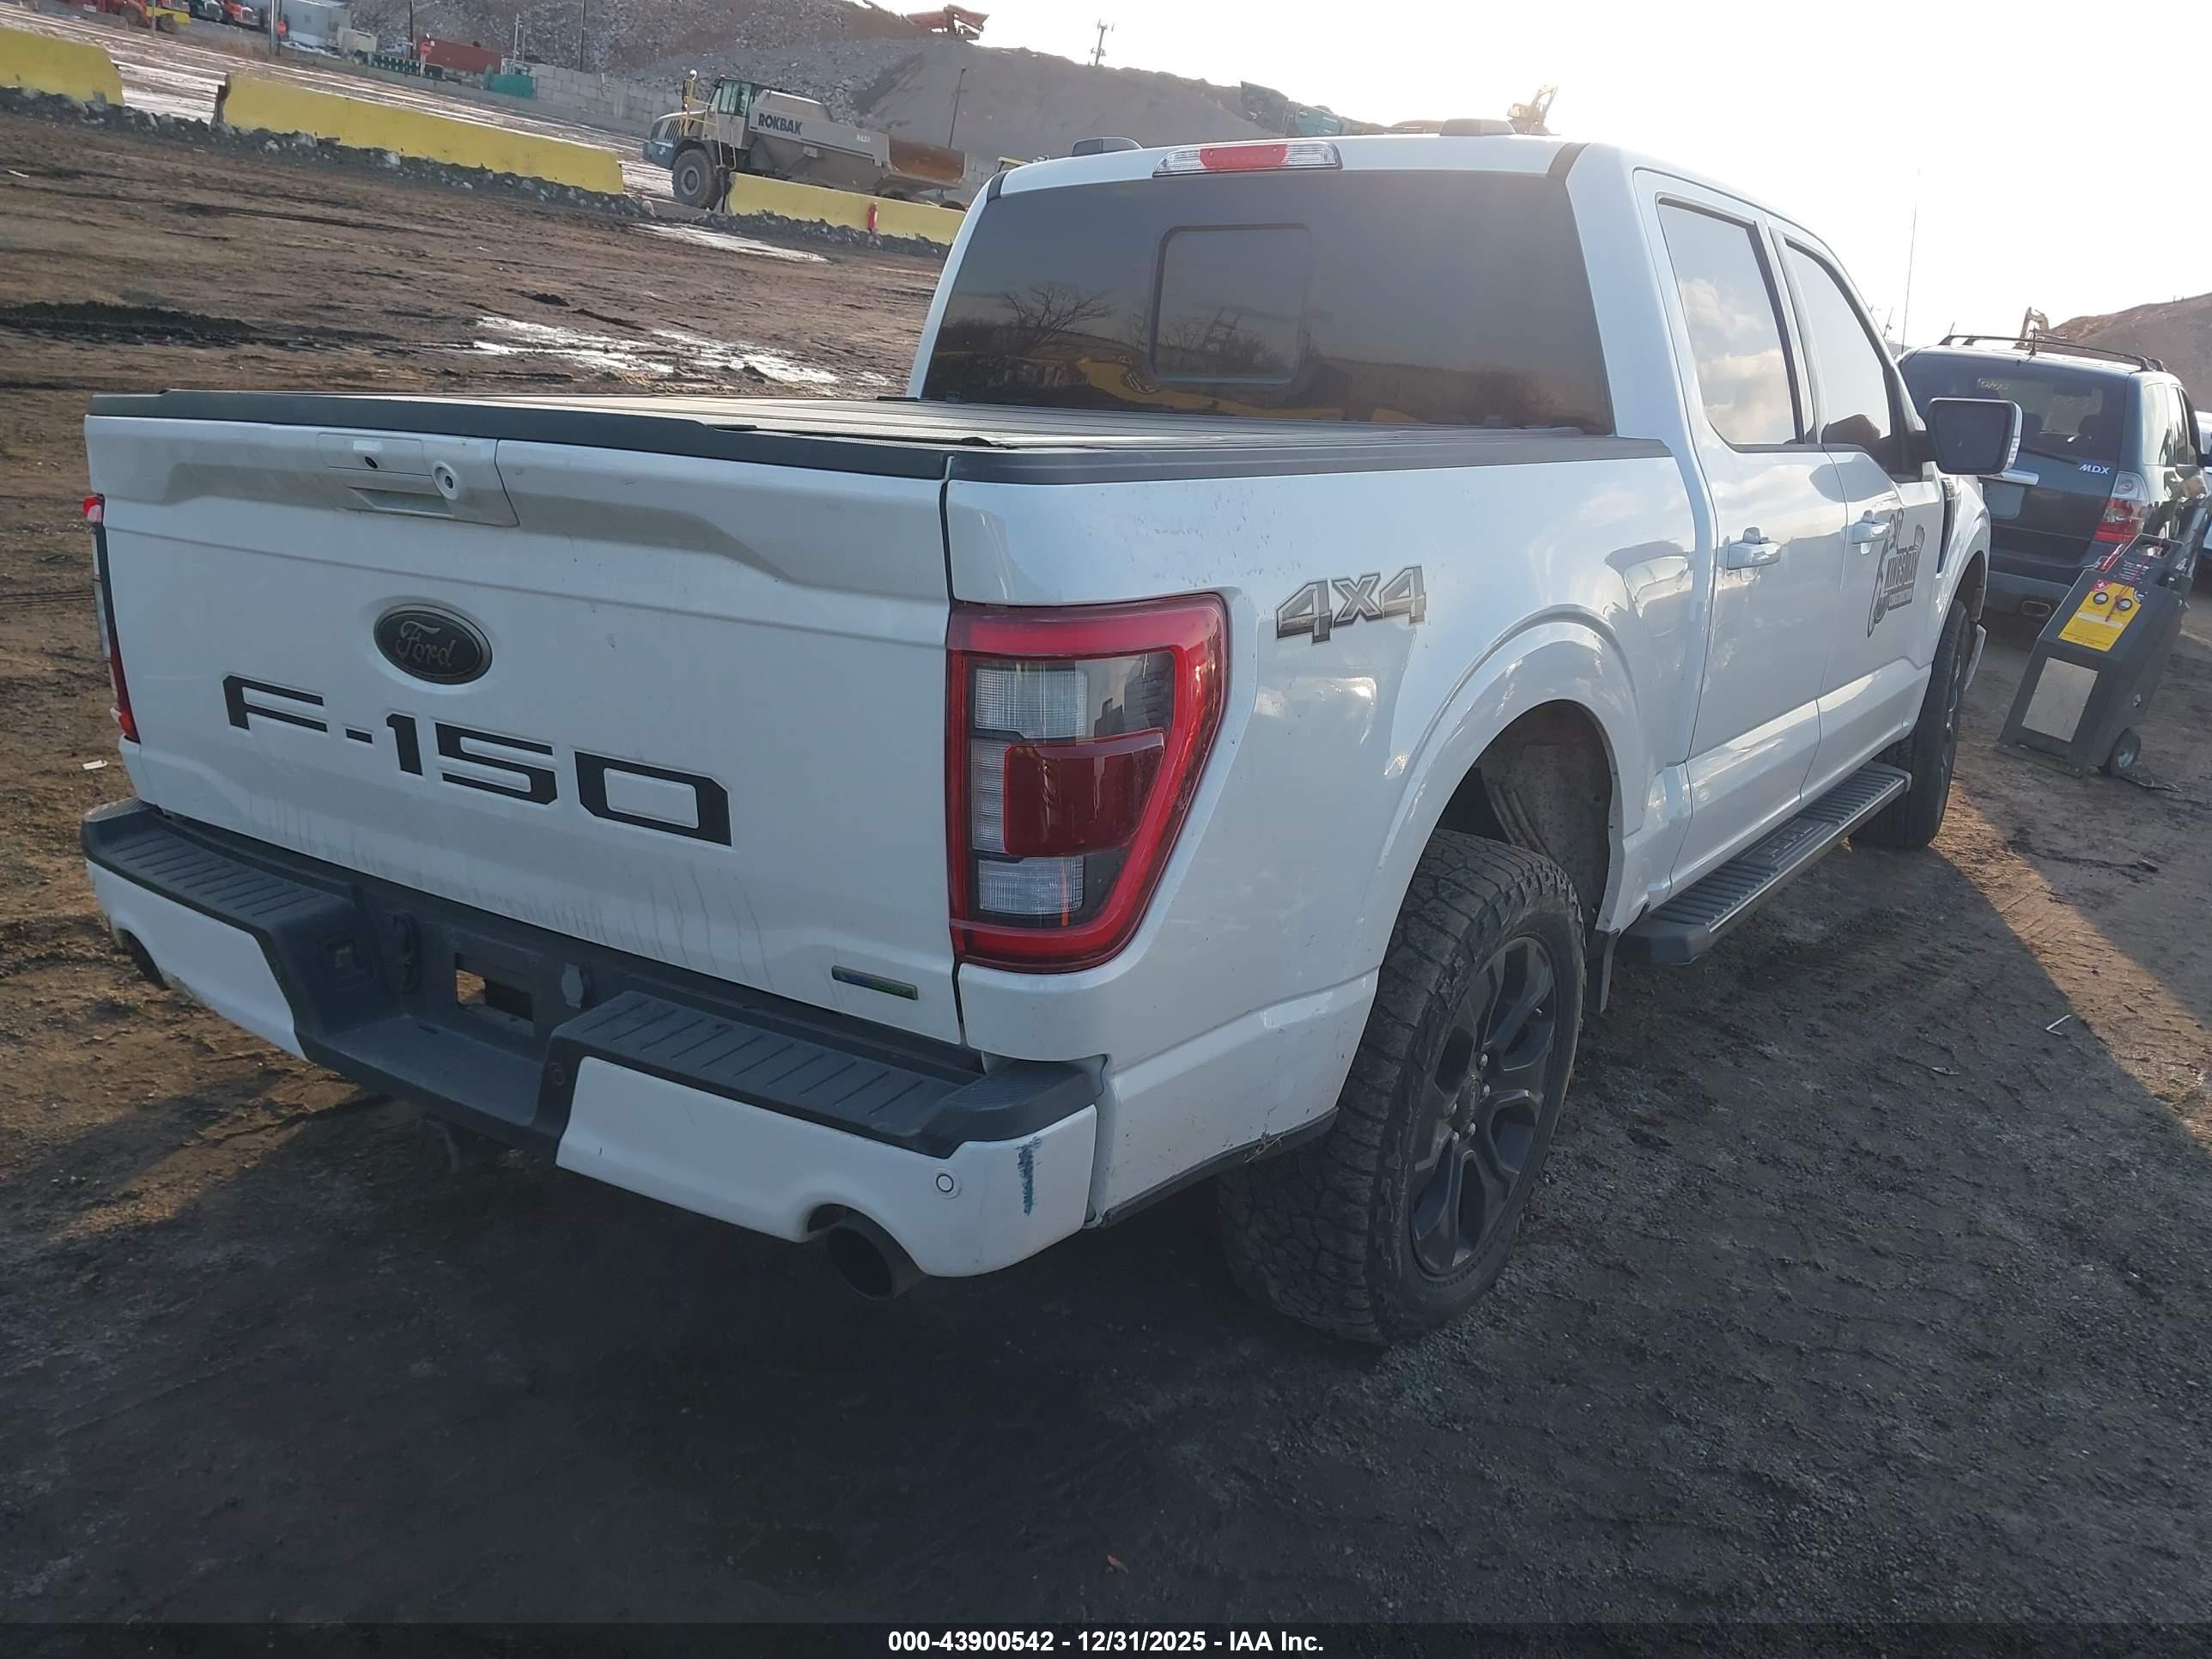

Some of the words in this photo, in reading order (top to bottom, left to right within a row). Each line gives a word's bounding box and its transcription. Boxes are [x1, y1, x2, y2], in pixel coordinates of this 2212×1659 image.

[757, 112, 803, 136] ROKBAK
[2078, 464, 2111, 475] MDX
[395, 620, 457, 667] Ford
[222, 674, 732, 847] F-150
